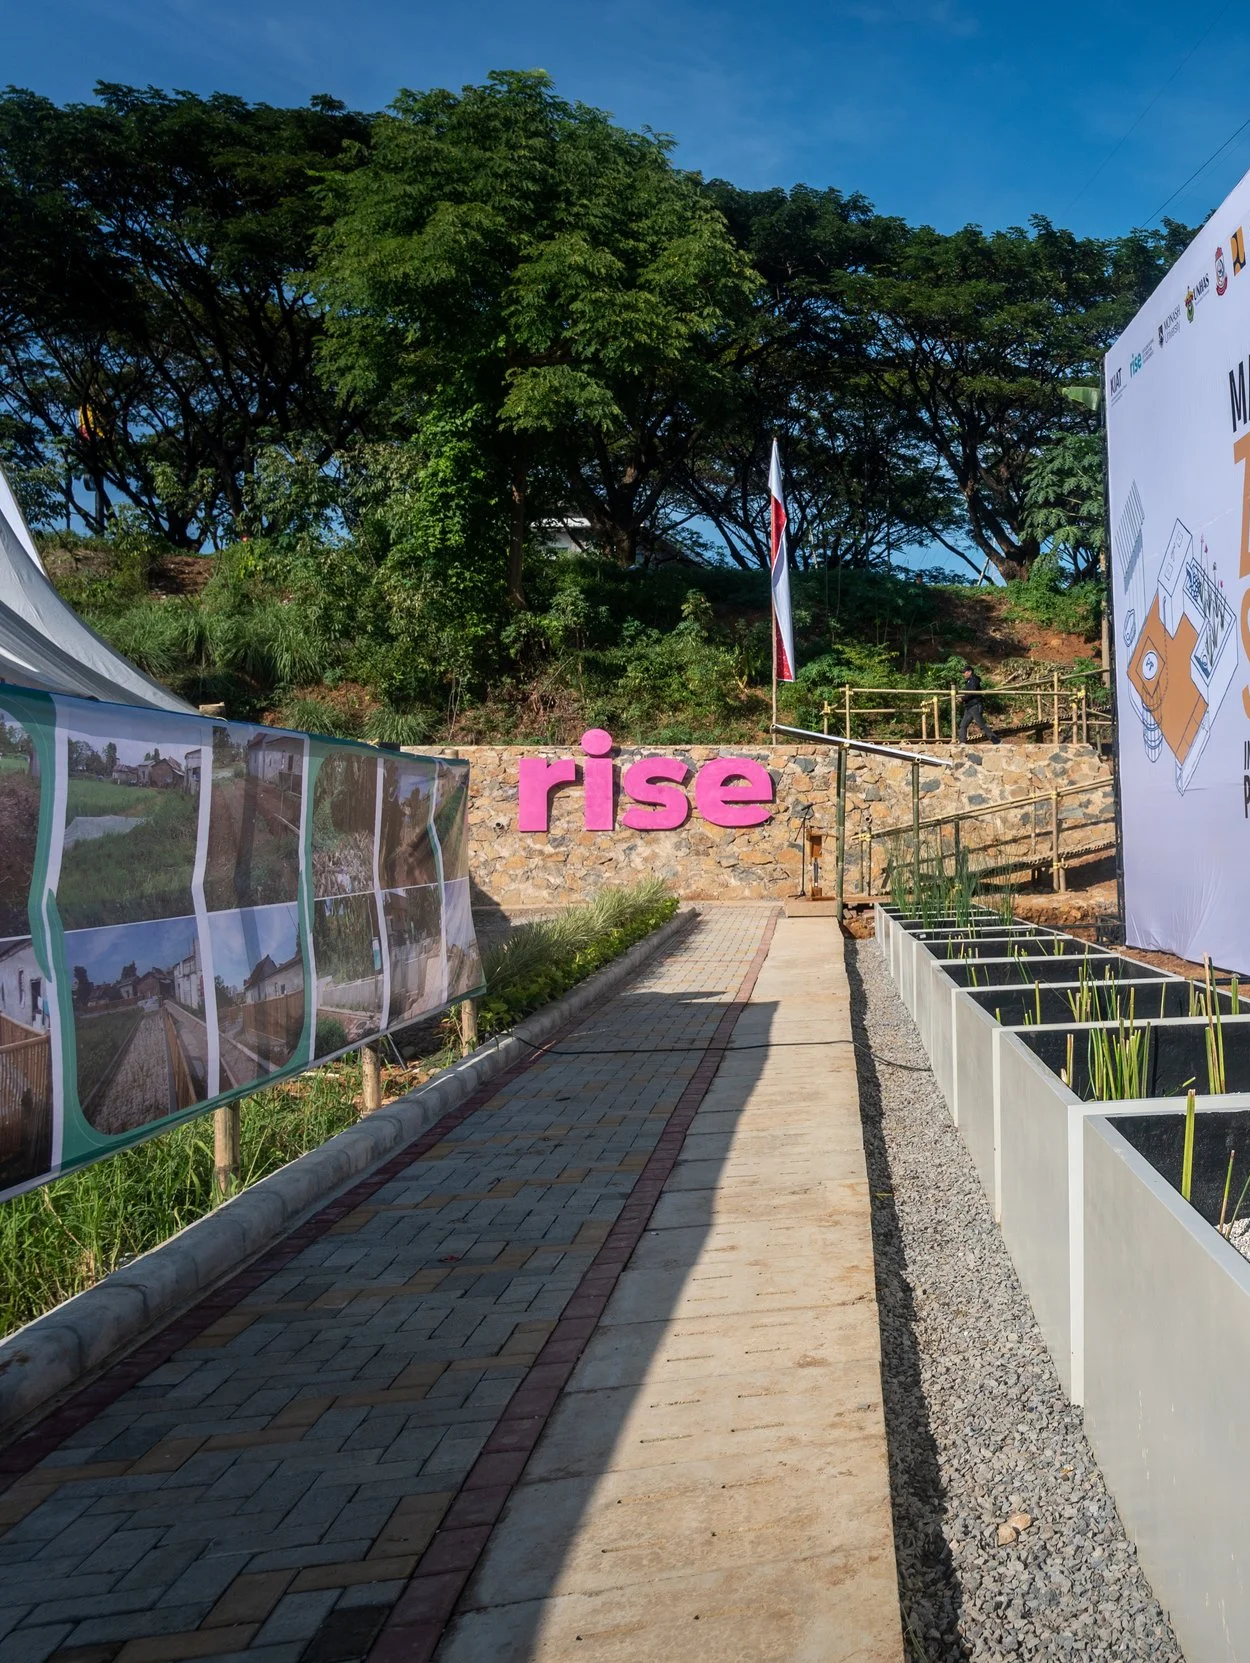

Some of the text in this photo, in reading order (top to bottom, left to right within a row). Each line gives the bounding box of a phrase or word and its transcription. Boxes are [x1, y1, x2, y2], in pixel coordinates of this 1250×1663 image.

[1193, 273, 1209, 300] UNHAS
[1163, 305, 1181, 329] MONASH
[1130, 353, 1142, 378] rise
[518, 728, 773, 832] rise
